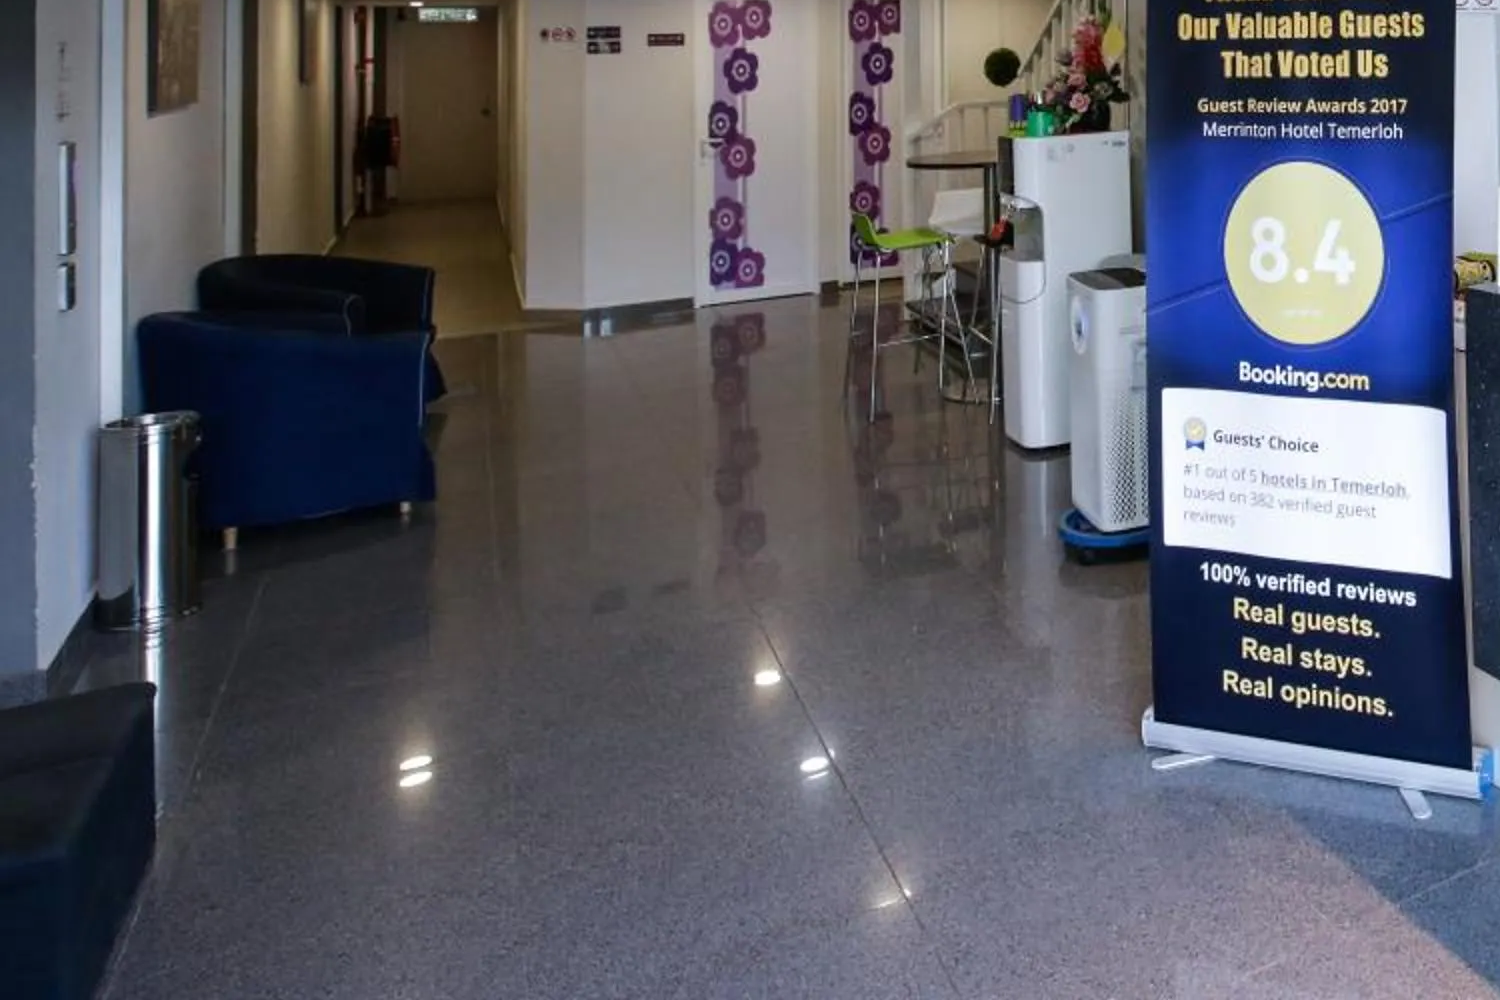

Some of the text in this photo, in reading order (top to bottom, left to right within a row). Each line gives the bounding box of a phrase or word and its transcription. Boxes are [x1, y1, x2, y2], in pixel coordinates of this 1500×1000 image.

[1177, 10, 1425, 40] Our Valuable Guests
[1221, 50, 1389, 78] That Voted Us
[1198, 98, 1407, 113] Guest Review Awards 2017
[1203, 122, 1403, 139] Merrinton Hotel Temerloh
[1250, 216, 1356, 285] 8.4
[1239, 361, 1370, 392] Booking.com
[1213, 429, 1320, 453] Guests' Choice
[1183, 464, 1200, 477] #1
[1205, 466, 1228, 480] out
[1231, 467, 1246, 481] of
[1260, 471, 1308, 490] hotels
[1311, 475, 1327, 491] in
[1183, 486, 1226, 502] based
[1229, 491, 1247, 504] on
[1278, 497, 1333, 514] verified
[1336, 503, 1377, 519] guest
[1183, 510, 1236, 527] reviews
[1200, 562, 1417, 607] 100% verified reviews
[1233, 597, 1380, 638] Real guests.
[1241, 637, 1372, 678] Real stays.
[1223, 670, 1394, 717] Real opinions.
